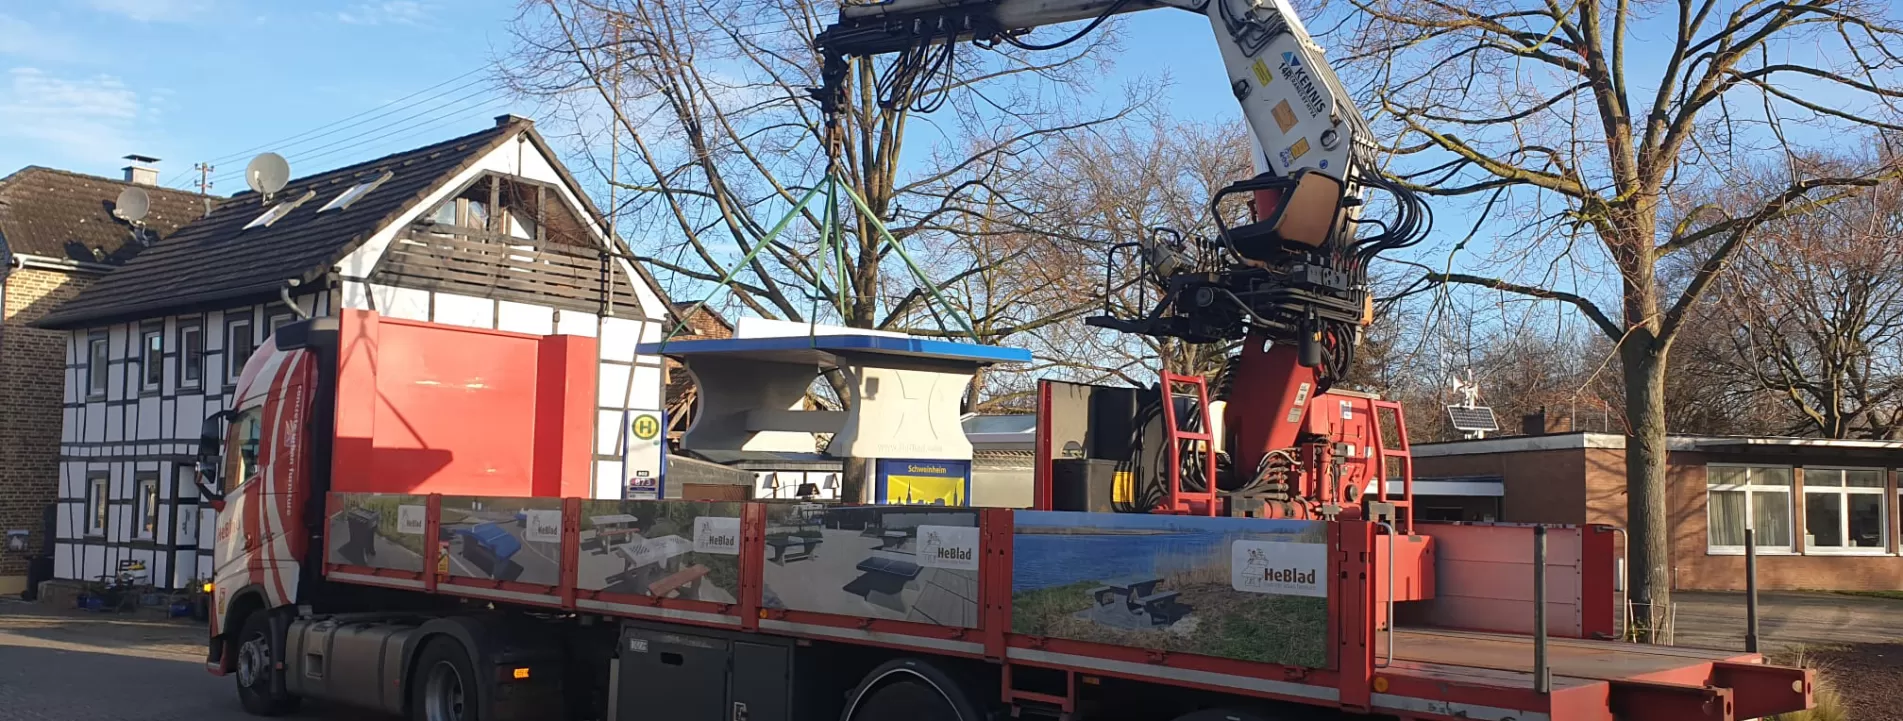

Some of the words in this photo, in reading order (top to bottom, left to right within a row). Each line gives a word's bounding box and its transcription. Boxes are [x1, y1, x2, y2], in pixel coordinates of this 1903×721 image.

[1278, 62, 1292, 80] 14R
[1295, 67, 1326, 113] KENNIS
[640, 421, 652, 434] H
[538, 525, 557, 536] HeBlad
[709, 535, 734, 546] HeBlad
[938, 547, 972, 560] HeBlad
[1264, 567, 1316, 584] HeBlad
